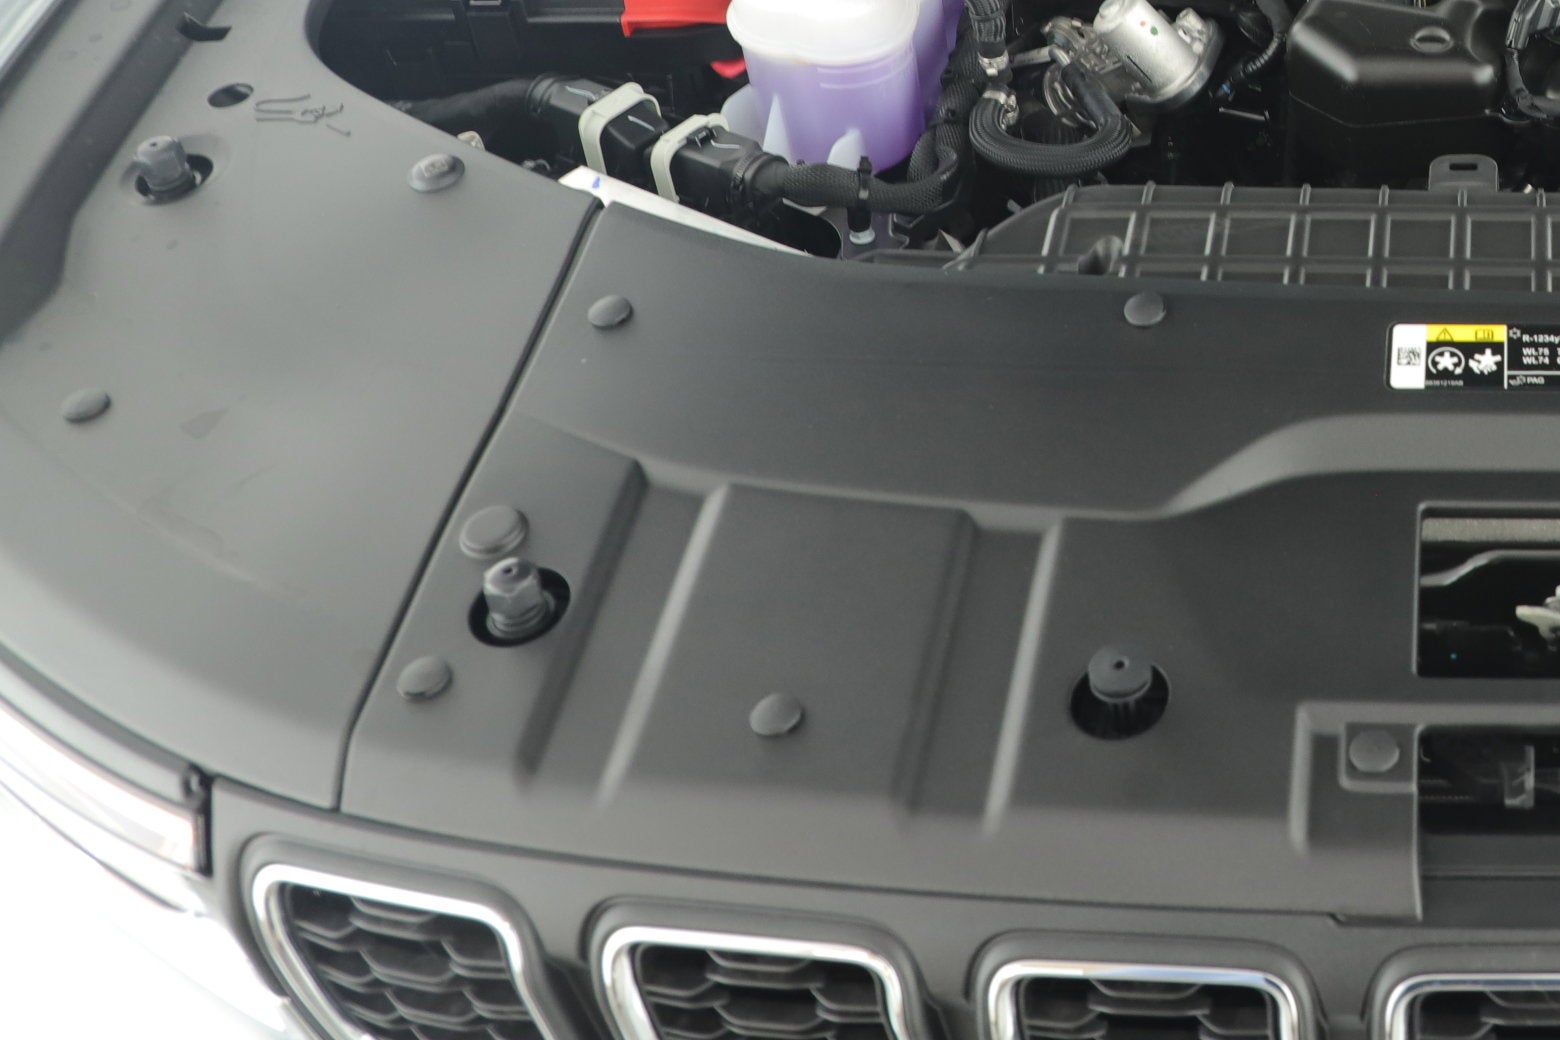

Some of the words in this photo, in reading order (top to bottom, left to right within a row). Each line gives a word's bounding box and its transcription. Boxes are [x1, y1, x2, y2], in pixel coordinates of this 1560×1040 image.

[1522, 347, 1550, 356] WL75
[1522, 356, 1550, 365] WL74
[1526, 375, 1545, 385] PAG
